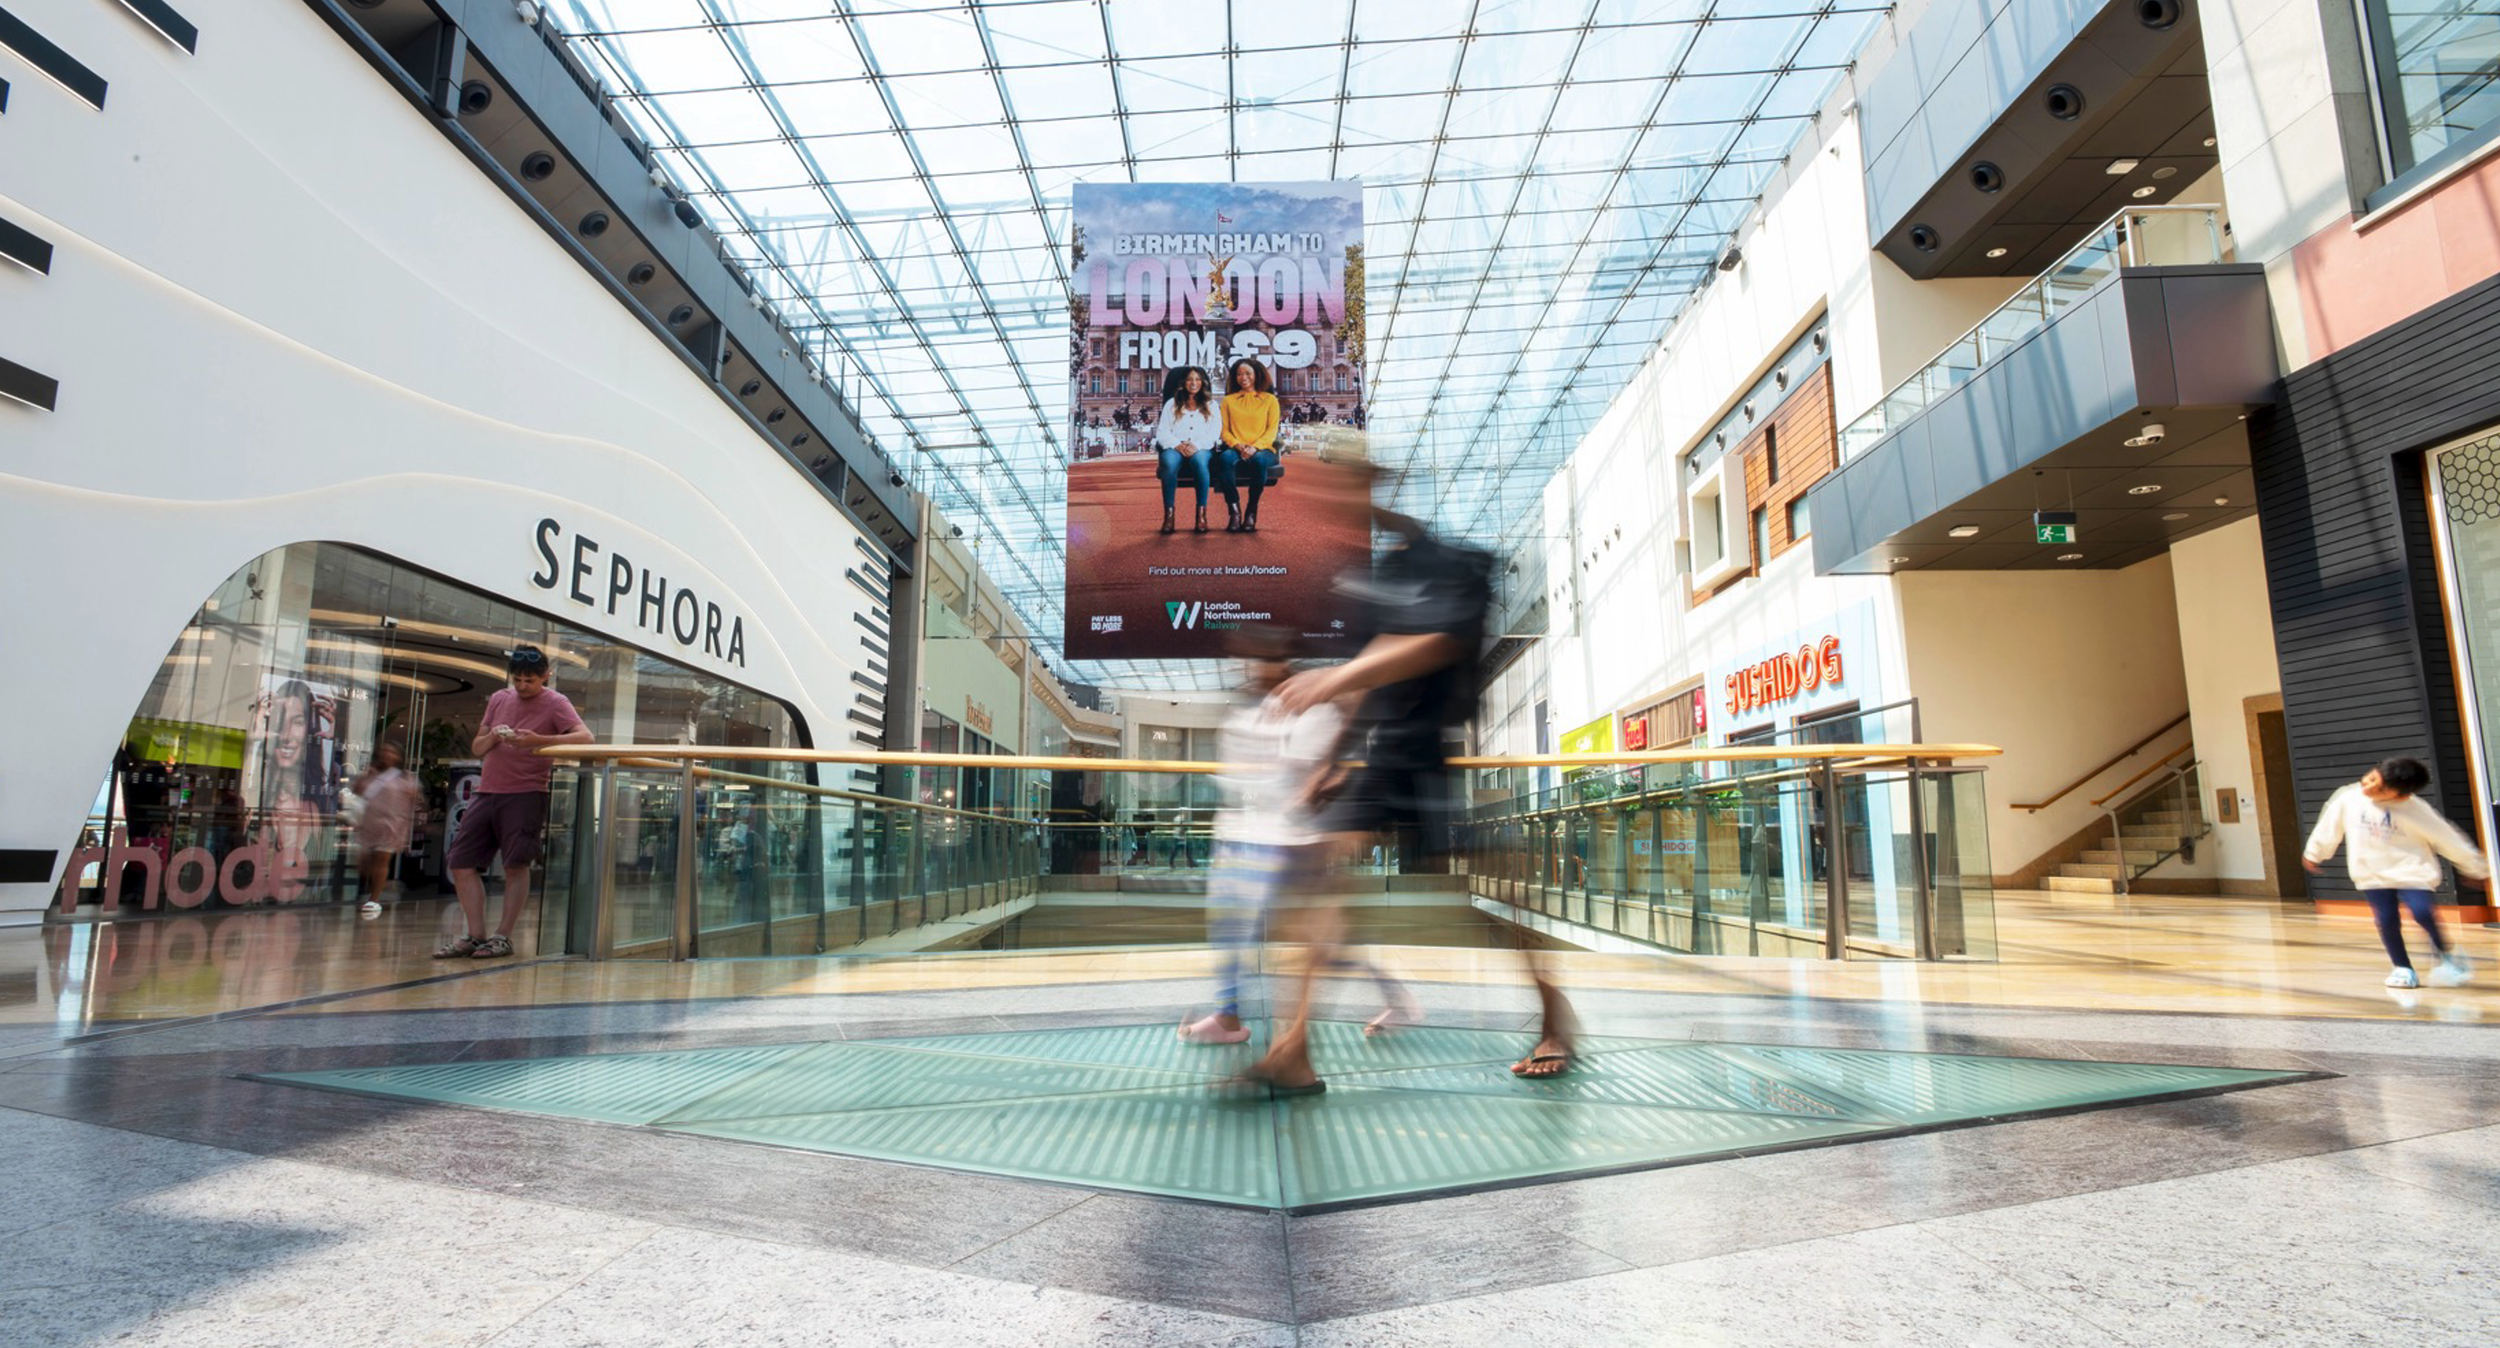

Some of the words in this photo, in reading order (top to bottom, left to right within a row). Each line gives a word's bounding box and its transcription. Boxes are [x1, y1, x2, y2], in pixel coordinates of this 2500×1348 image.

[1116, 233, 1291, 255] BIRMINGHAM
[1299, 233, 1323, 253] TO
[1089, 256, 1346, 326] LONDON
[1119, 330, 1216, 370] FROM
[1228, 329, 1317, 369] £9
[1149, 566, 1168, 576] Find
[1170, 567, 1186, 576] out
[1188, 568, 1211, 576] more
[1213, 567, 1222, 575] at
[1225, 565, 1287, 575] lnr.uk/london
[531, 517, 746, 668] SEPHORA
[1204, 601, 1241, 611] London
[1204, 611, 1271, 620] Northwestern
[1091, 622, 1101, 630] DO
[1204, 621, 1241, 630] Railway
[1725, 634, 1843, 715] SUSHIDOG
[60, 826, 310, 914] rhode
